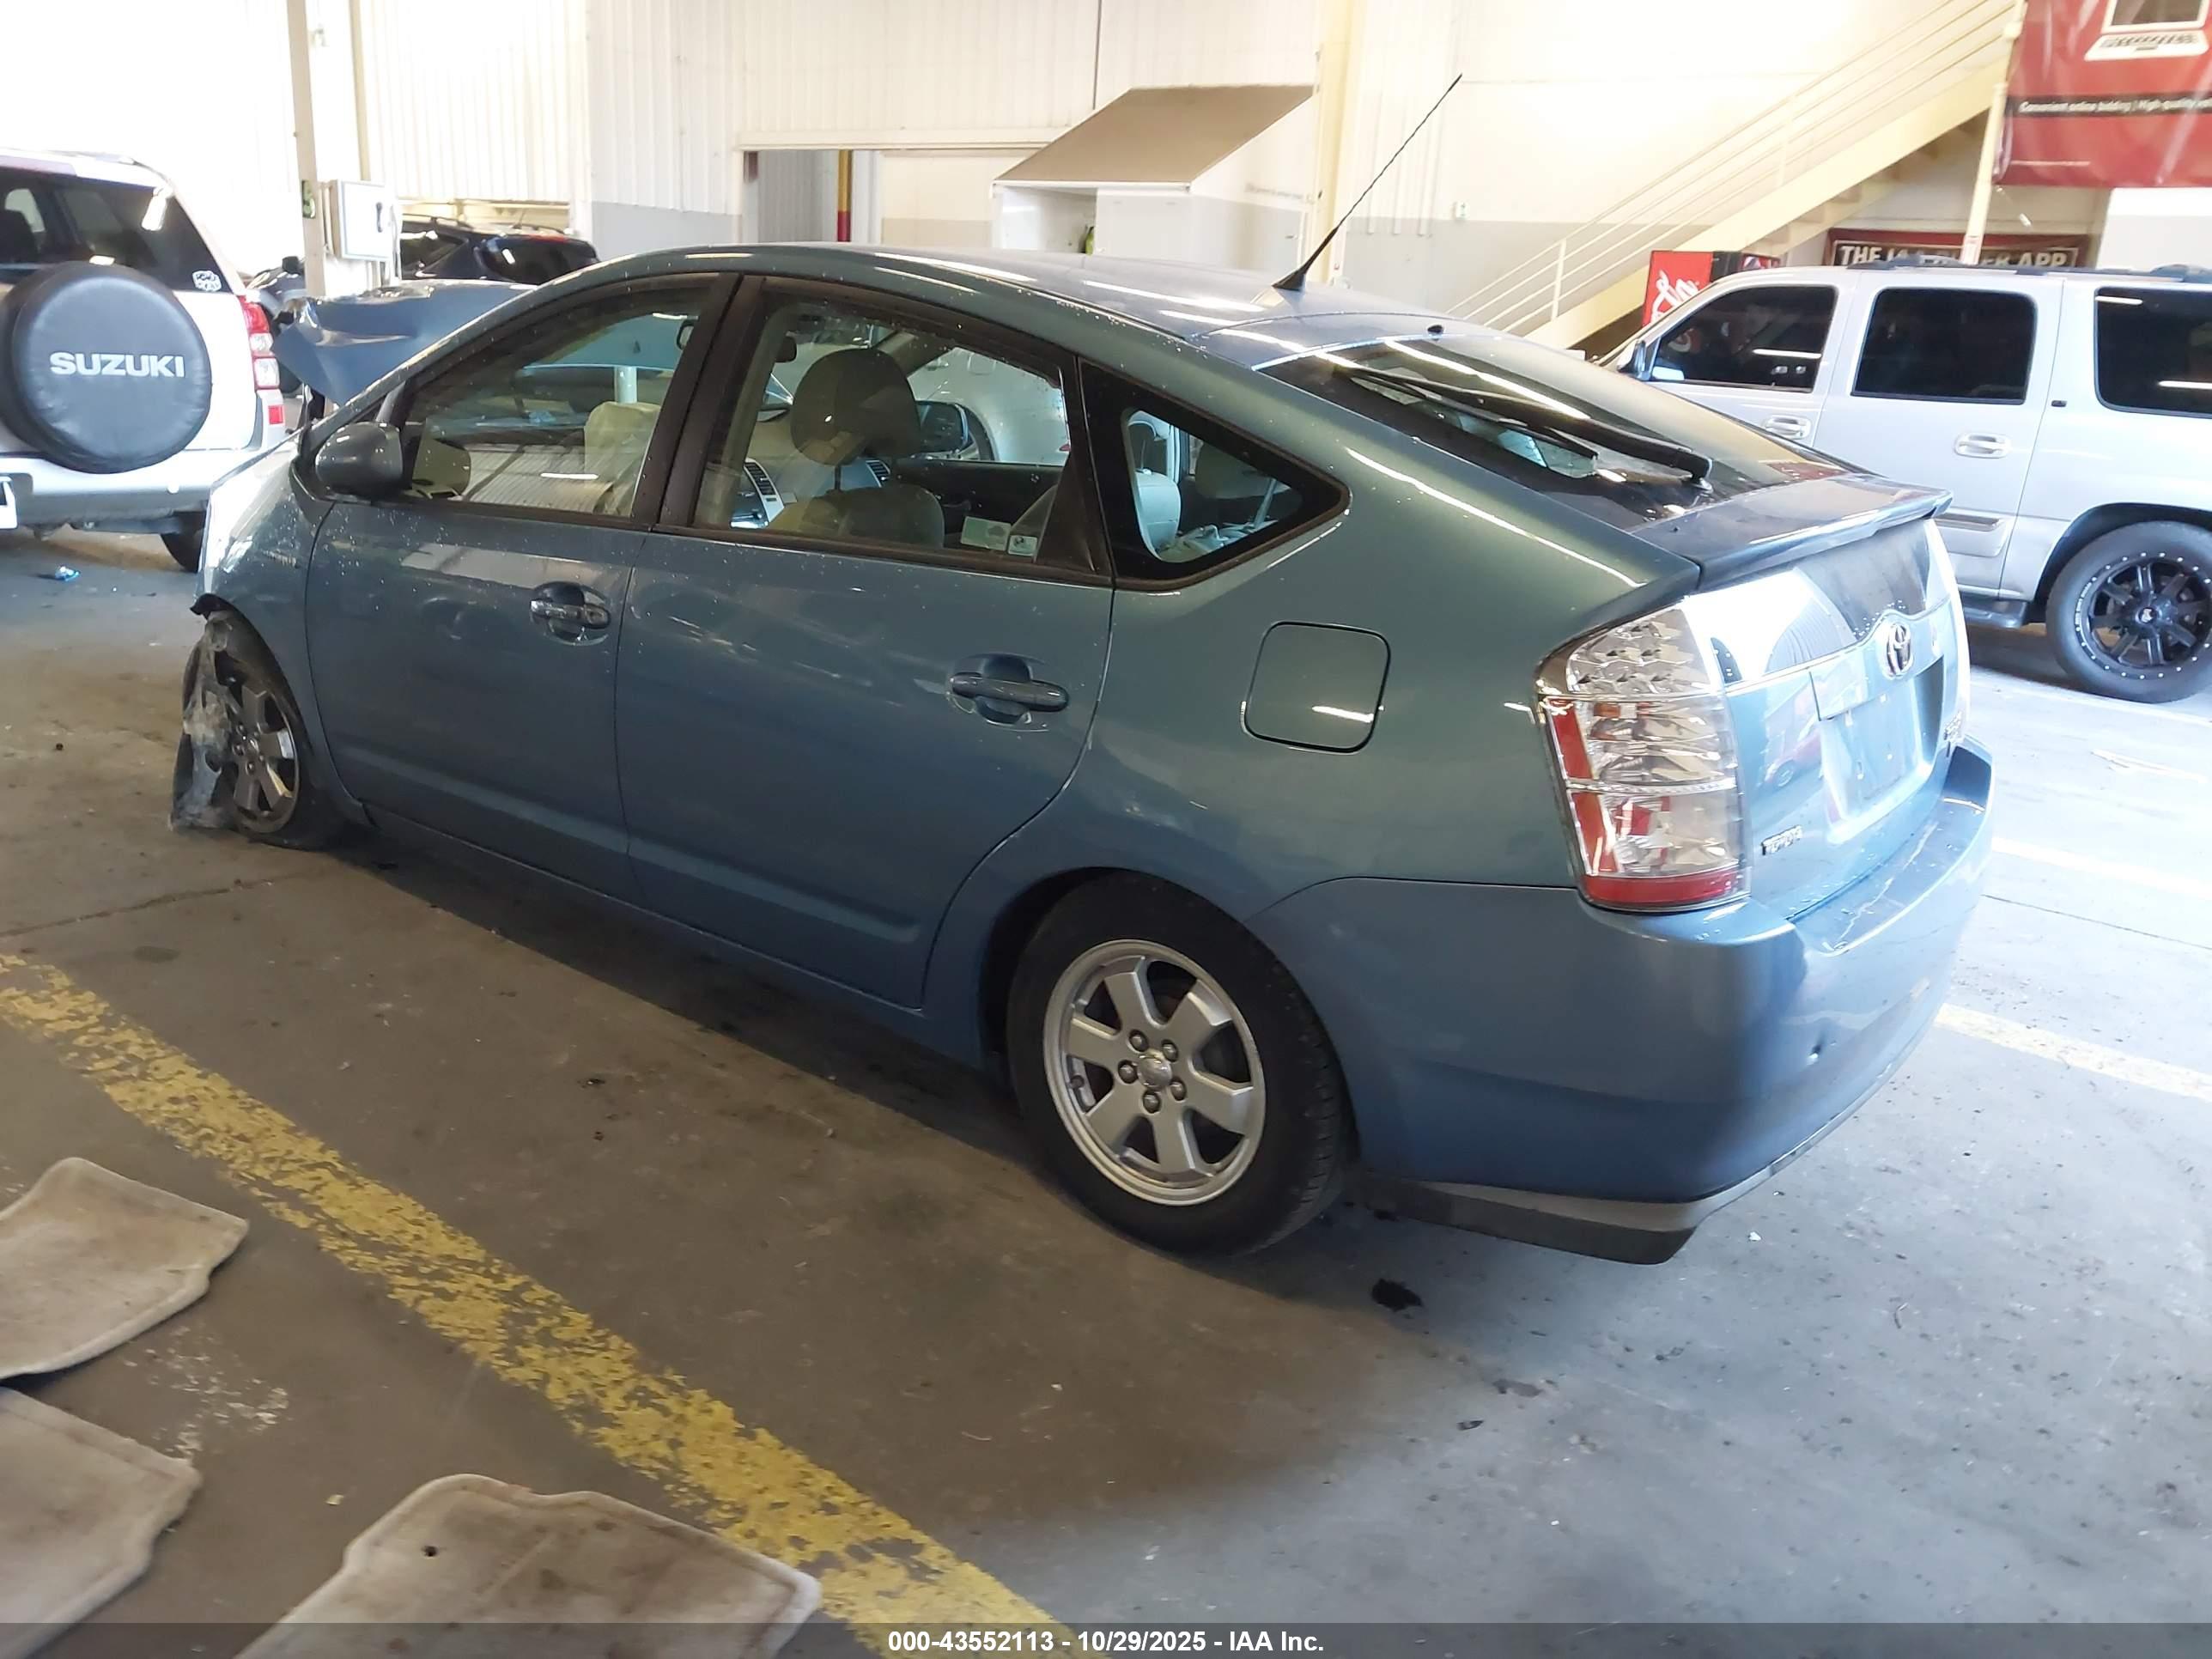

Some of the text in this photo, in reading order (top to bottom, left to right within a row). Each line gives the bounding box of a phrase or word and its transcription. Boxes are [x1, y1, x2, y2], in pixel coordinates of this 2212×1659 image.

[1840, 246, 1883, 266] THE
[2019, 252, 2068, 267] APP
[50, 352, 185, 378] SUZUKI
